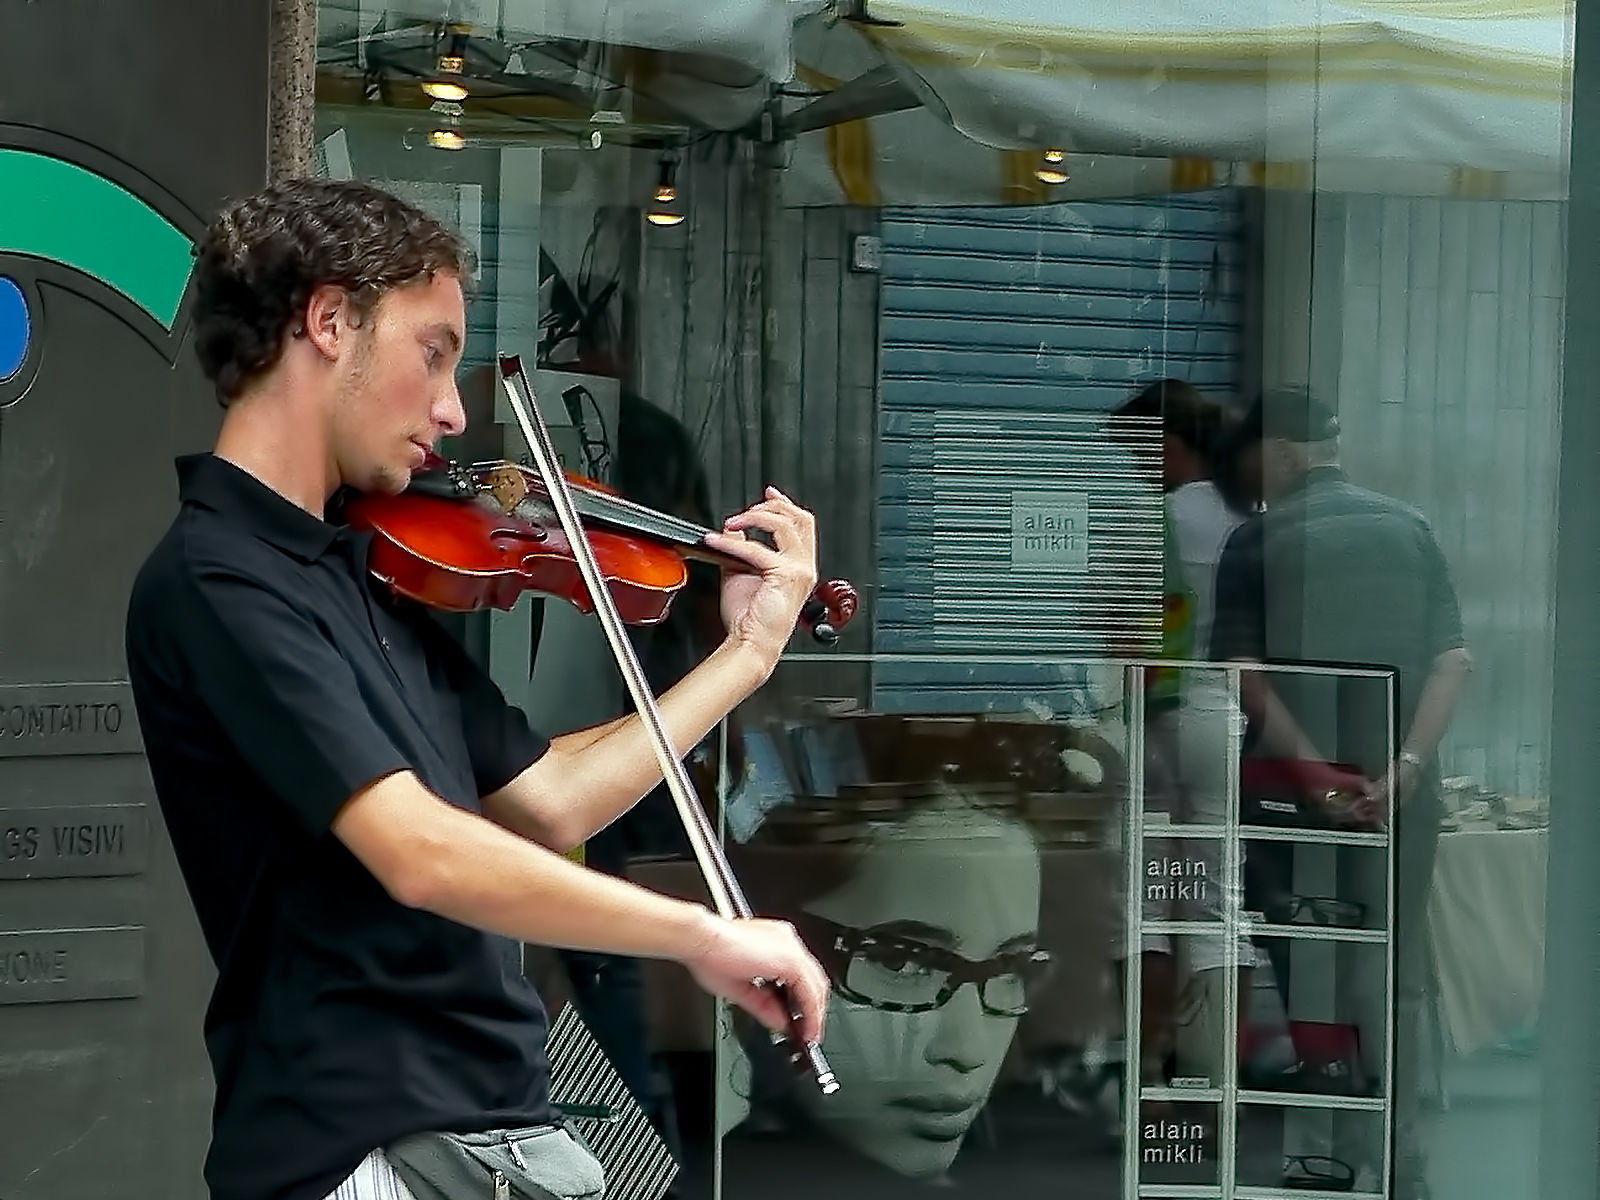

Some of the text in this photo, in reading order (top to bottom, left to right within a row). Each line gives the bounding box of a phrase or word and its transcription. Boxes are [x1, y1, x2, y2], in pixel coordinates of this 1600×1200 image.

[1024, 513, 1075, 530] alain
[53, 824, 124, 856] VISIVI
[1147, 857, 1207, 876] alain
[1147, 880, 1206, 900] mikli
[1144, 1120, 1204, 1139] alain
[1143, 1144, 1202, 1164] mikli
